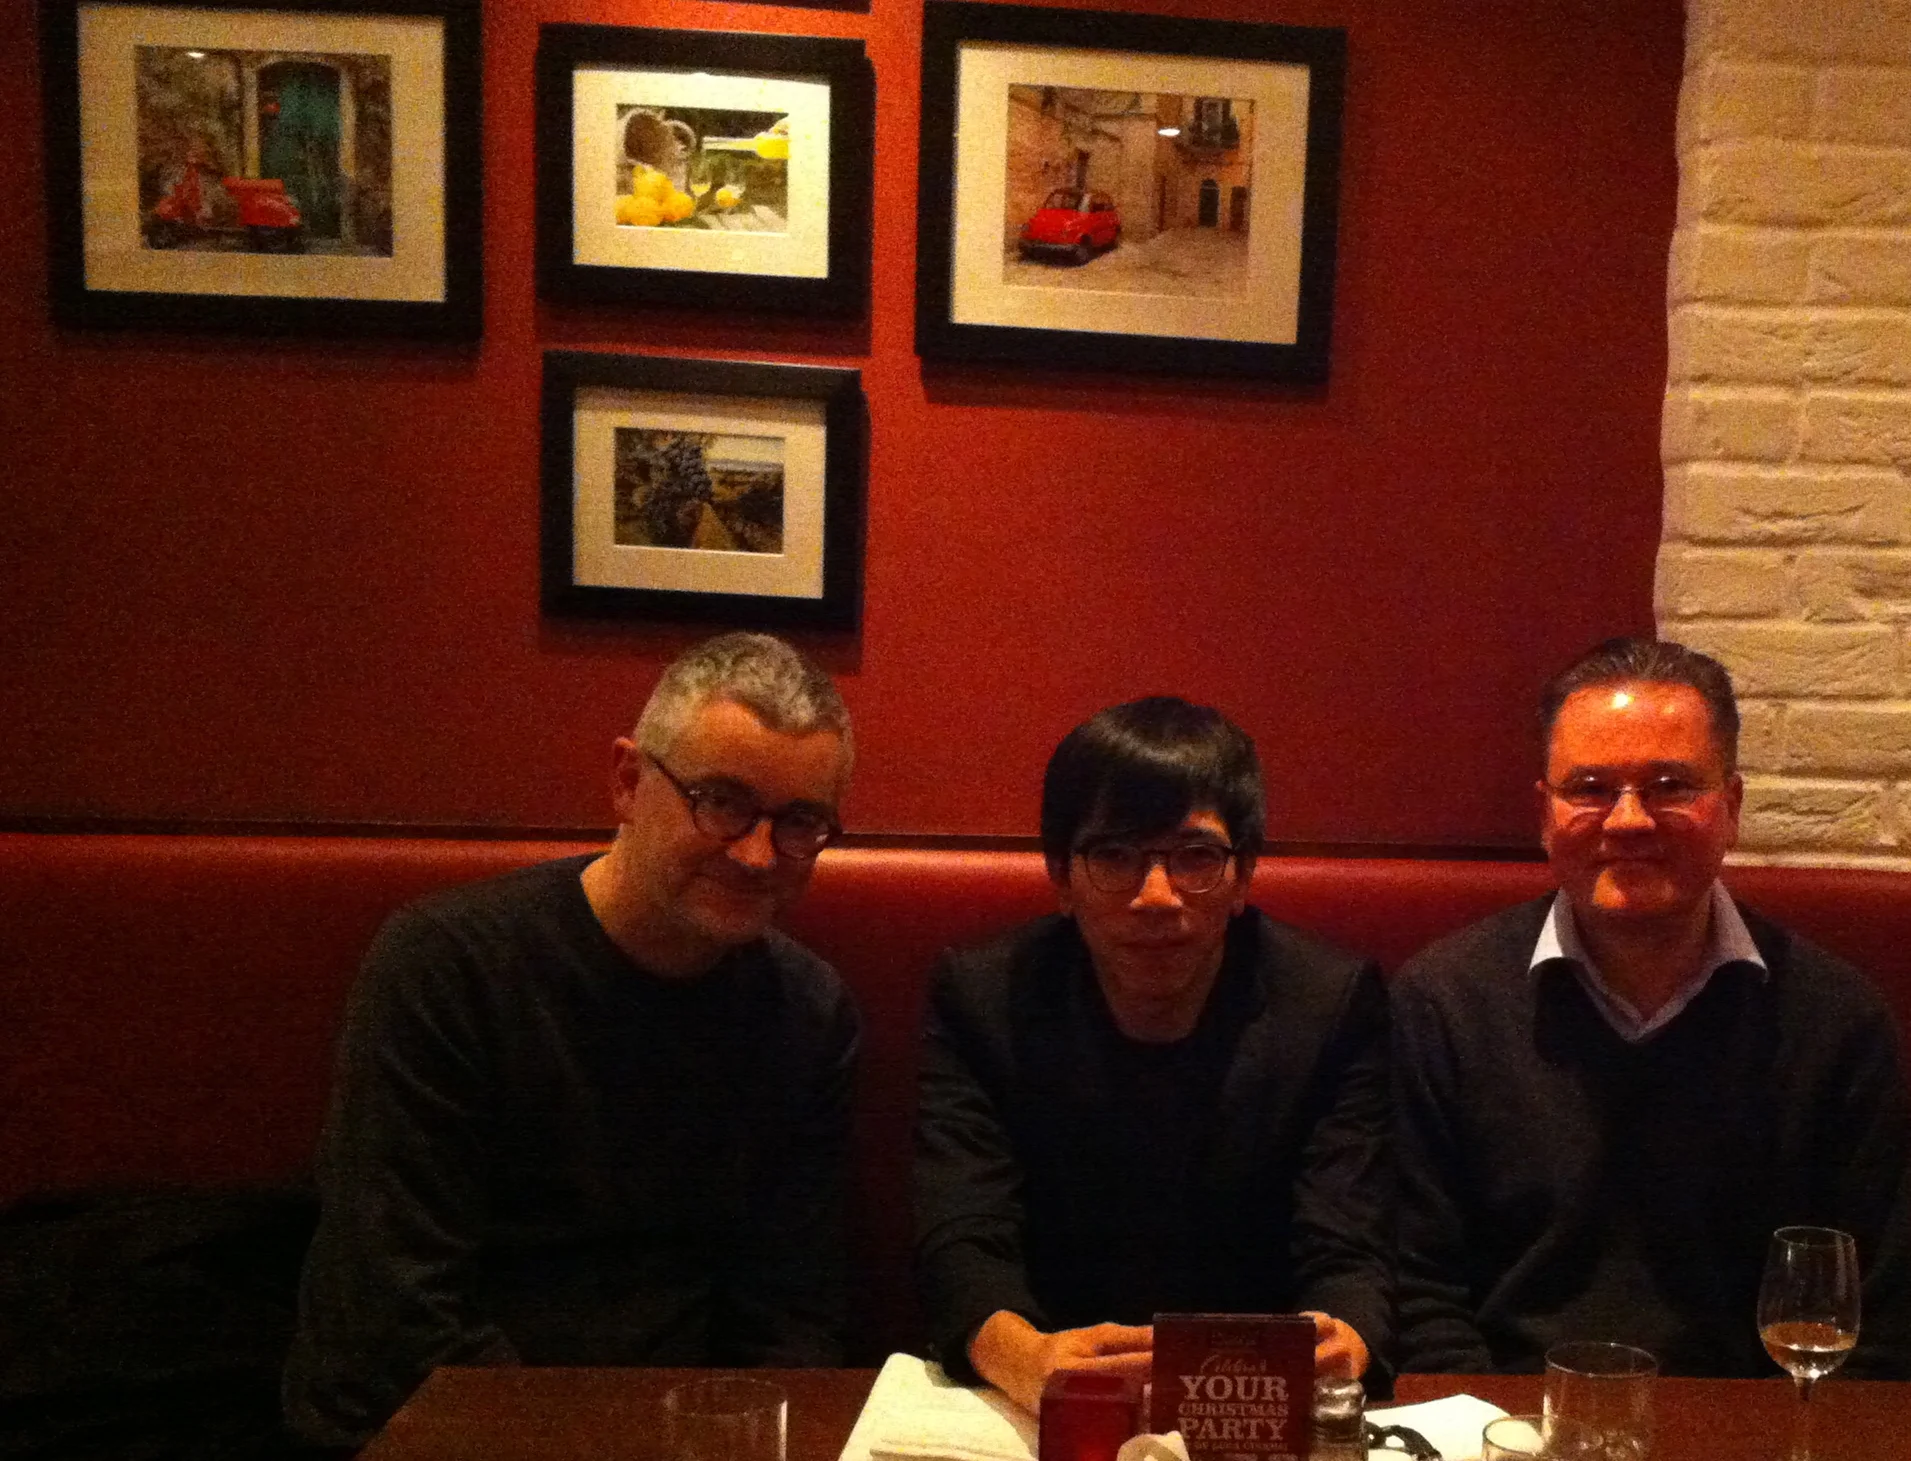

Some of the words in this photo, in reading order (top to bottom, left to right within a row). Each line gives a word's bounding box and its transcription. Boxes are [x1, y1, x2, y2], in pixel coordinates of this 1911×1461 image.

[1179, 1375, 1289, 1401] YOUR
[1178, 1403, 1289, 1416] CHRISTMAS
[1178, 1417, 1288, 1440] PARTY
